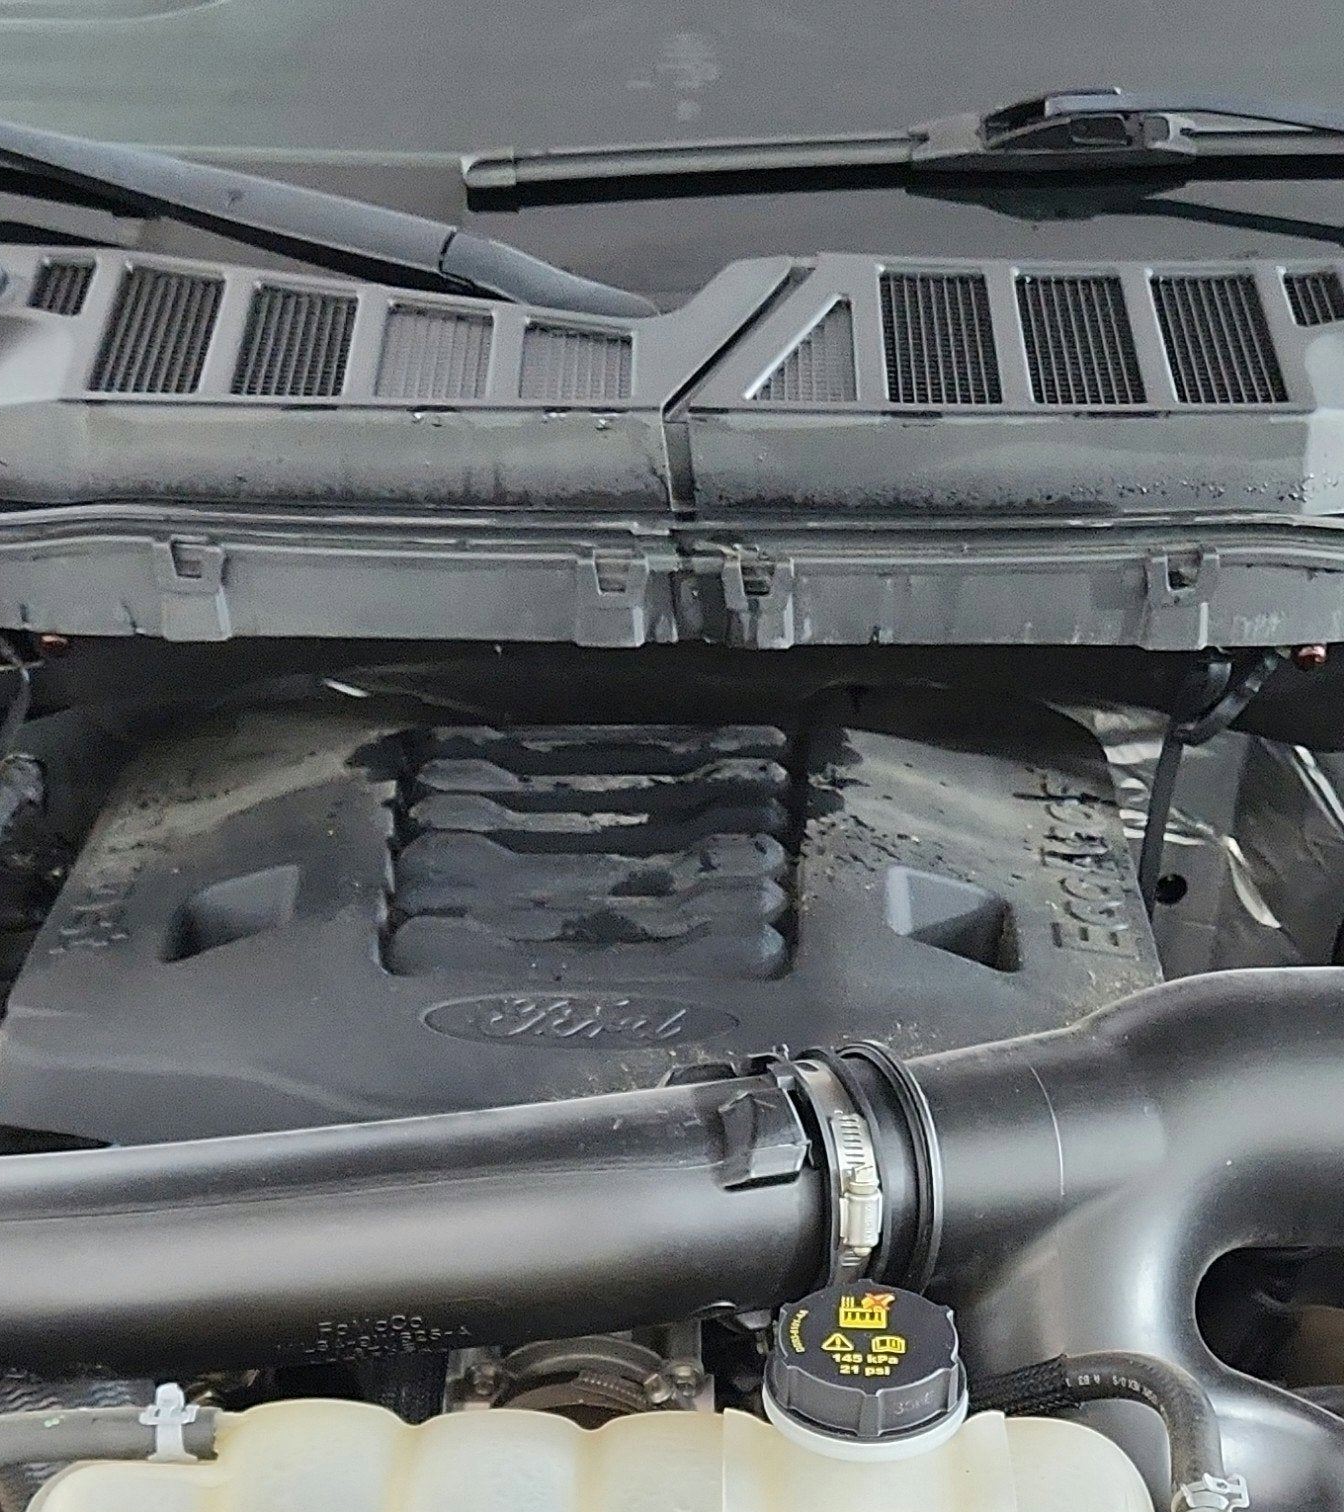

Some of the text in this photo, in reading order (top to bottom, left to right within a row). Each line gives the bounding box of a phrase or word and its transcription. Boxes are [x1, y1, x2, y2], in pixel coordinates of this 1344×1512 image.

[832, 1353, 899, 1365] 145 kPa
[839, 1364, 891, 1376] 21 psi
